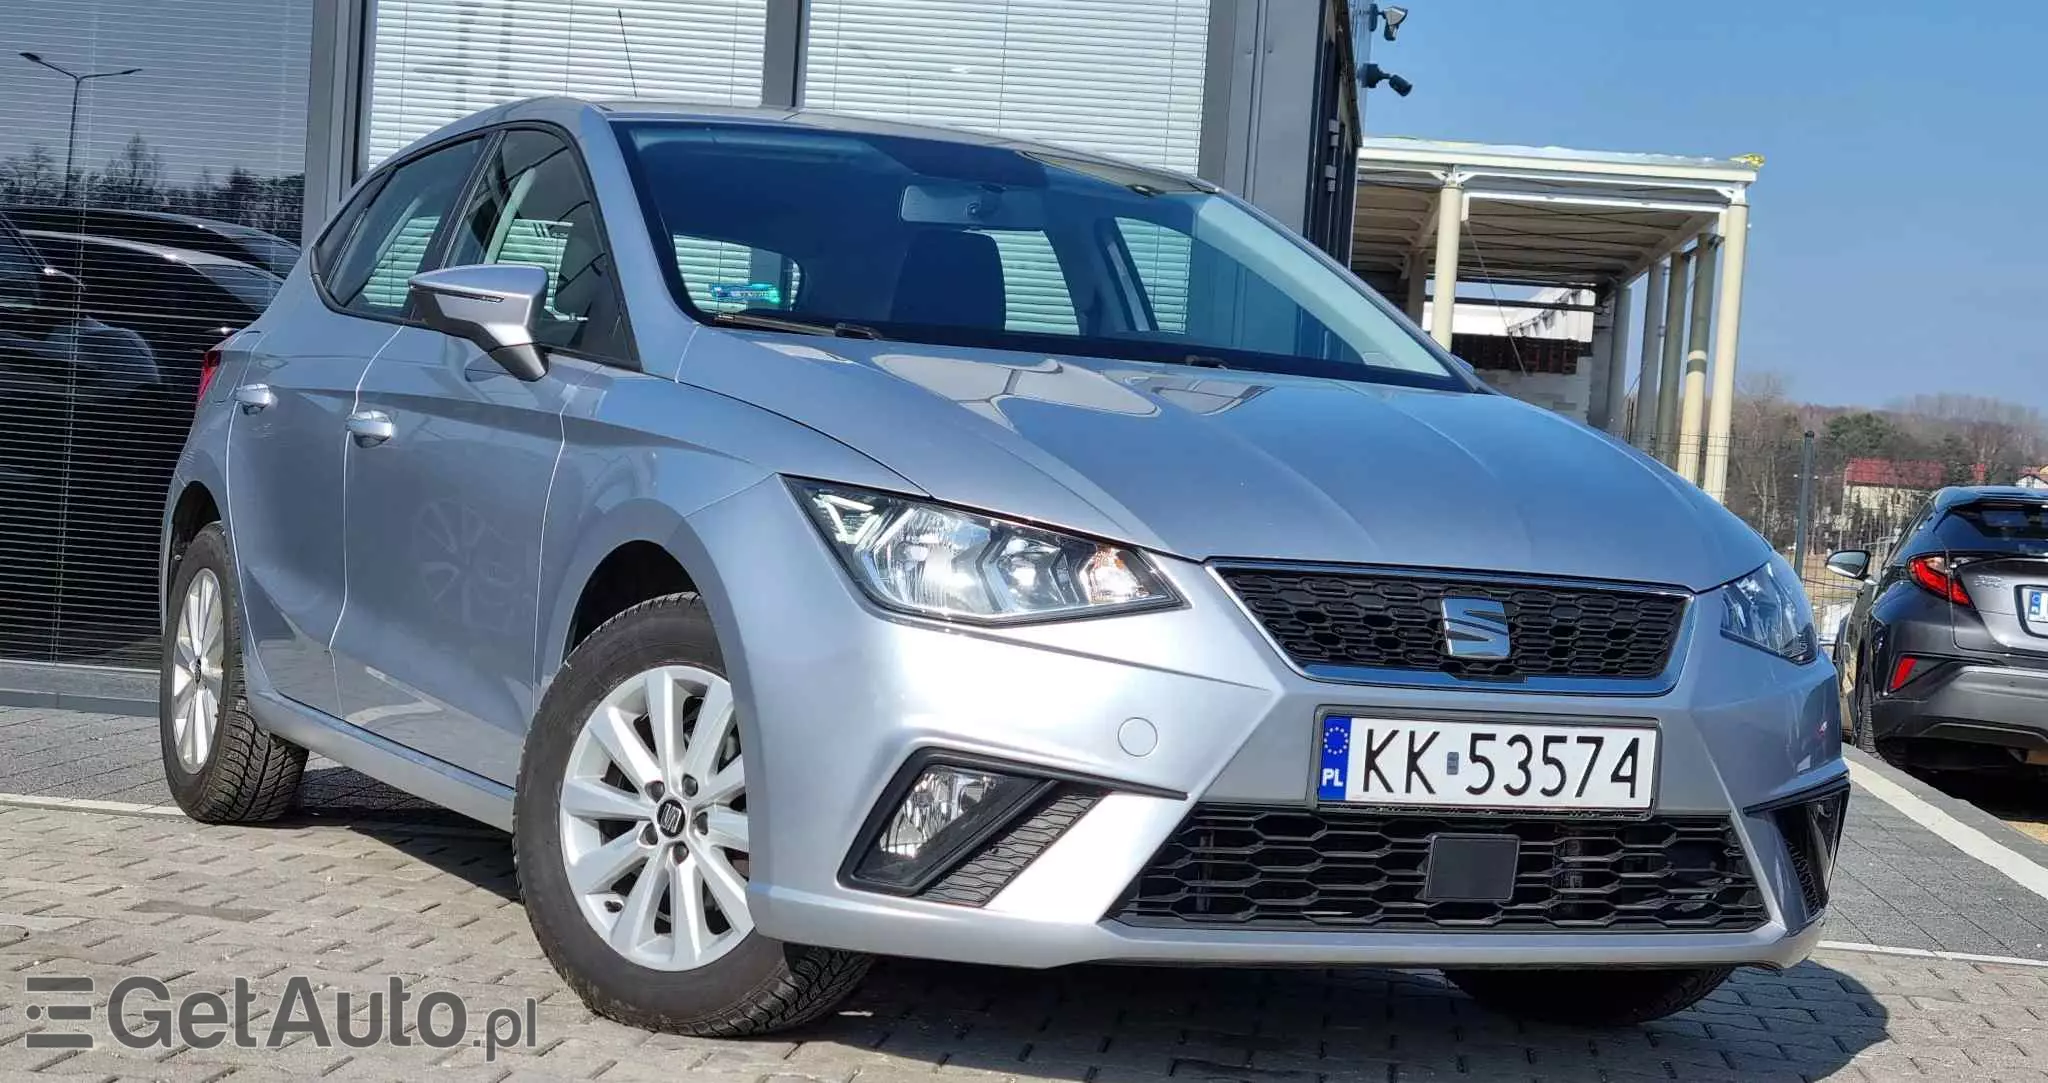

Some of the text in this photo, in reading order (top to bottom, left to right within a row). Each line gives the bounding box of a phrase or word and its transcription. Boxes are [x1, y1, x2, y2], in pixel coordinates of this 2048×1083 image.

[1322, 768, 1343, 787] PL
[1363, 728, 1640, 798] KK 53574
